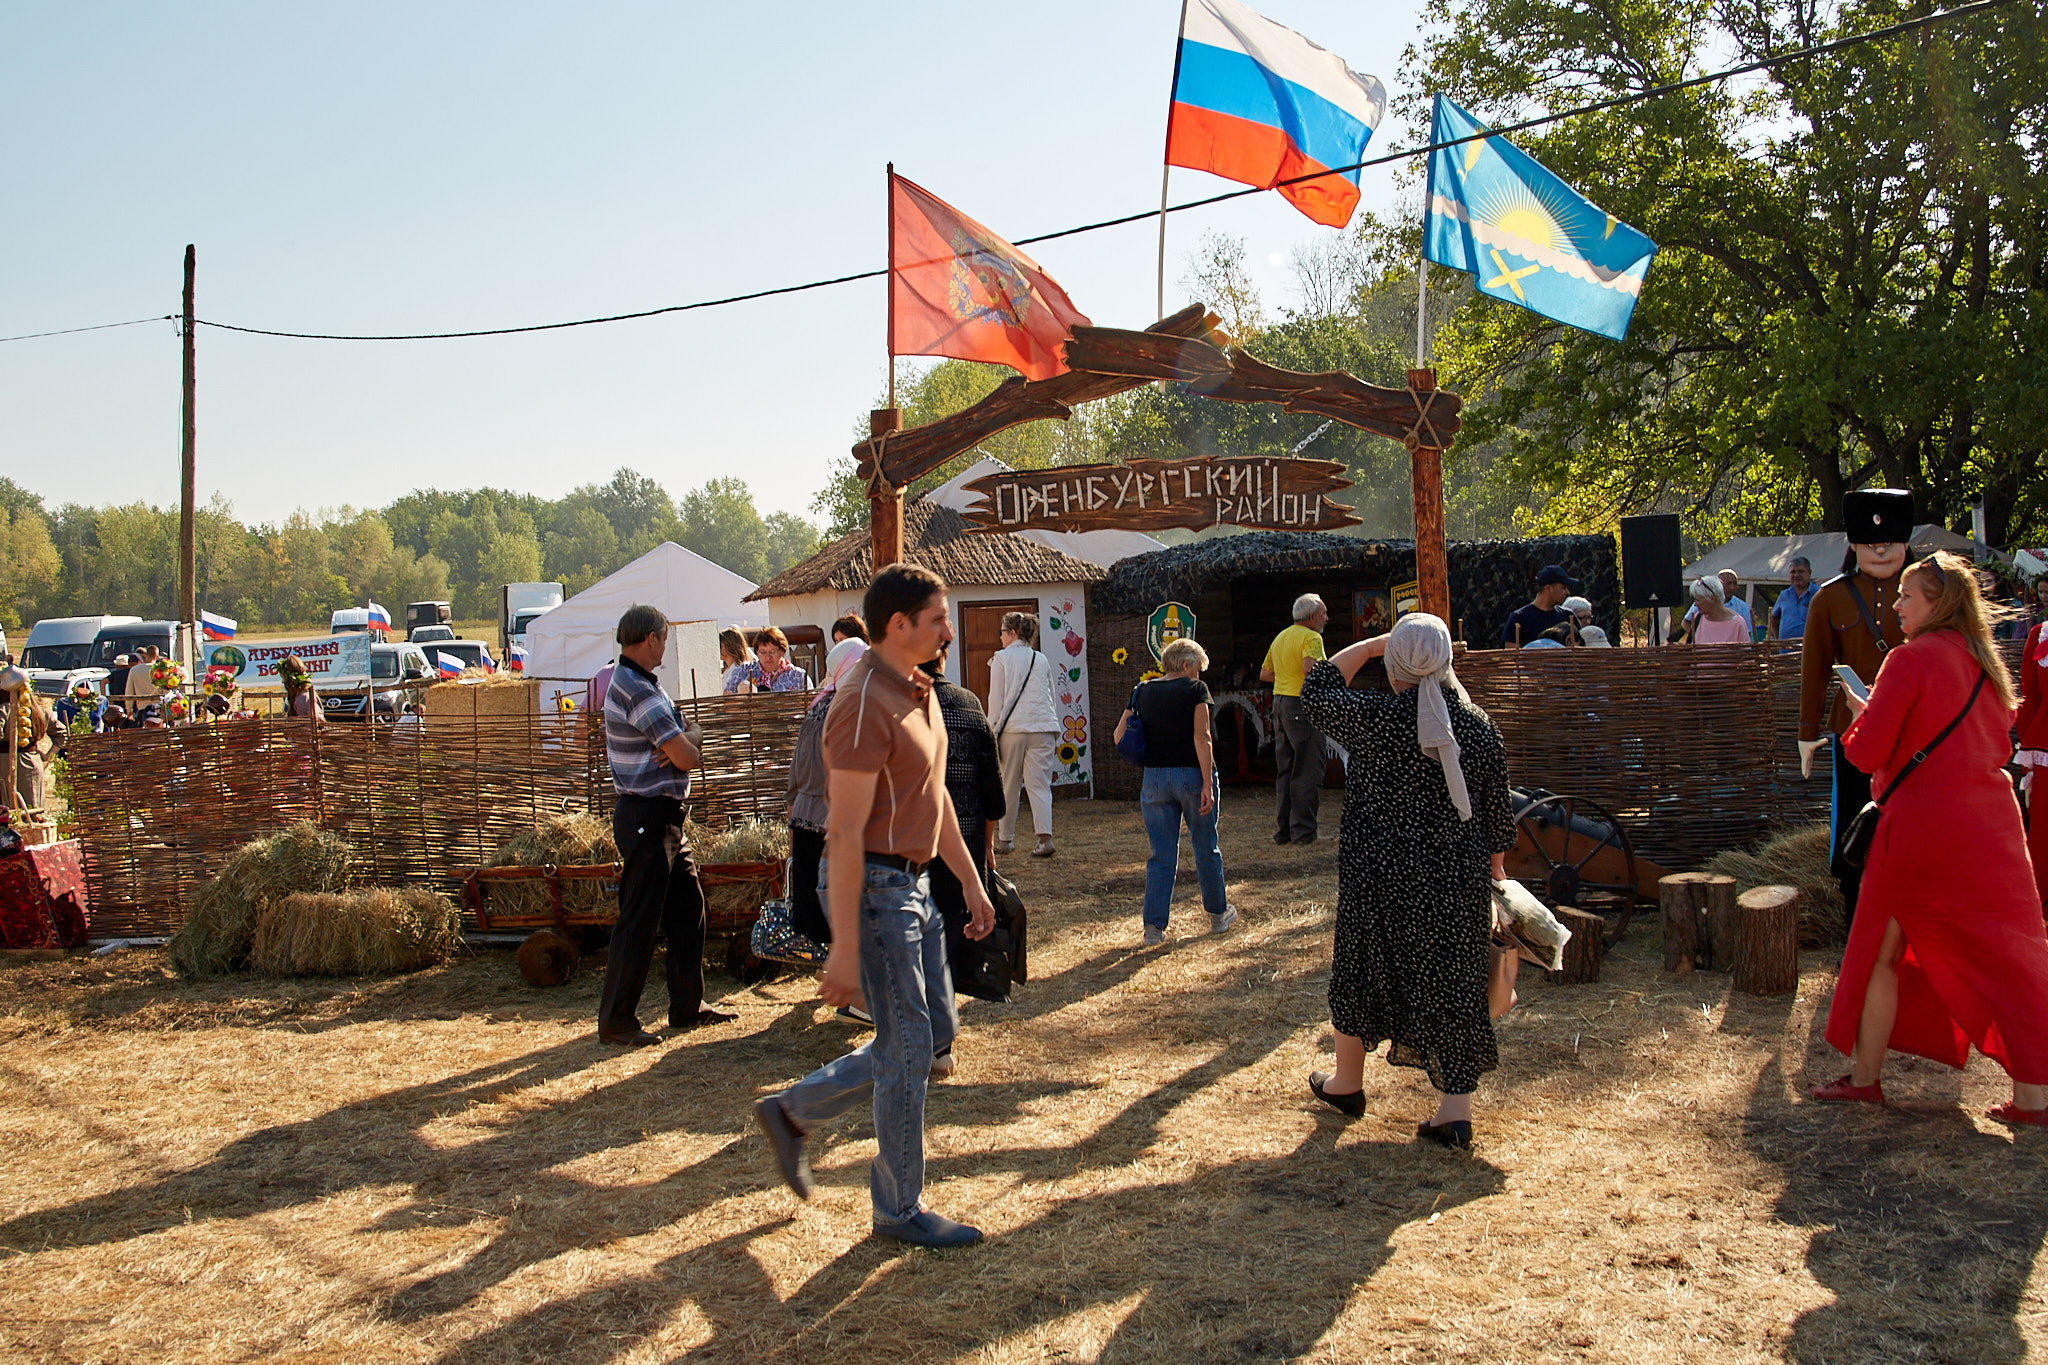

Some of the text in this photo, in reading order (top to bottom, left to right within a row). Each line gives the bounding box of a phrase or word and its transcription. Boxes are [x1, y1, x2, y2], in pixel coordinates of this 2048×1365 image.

[995, 460, 1279, 525] ОРЕНБУРГСКИЙ
[1215, 482, 1321, 530] РАЙОН
[248, 641, 340, 661] АРБУЗНЫЙ
[257, 659, 333, 677] БОИНГ
